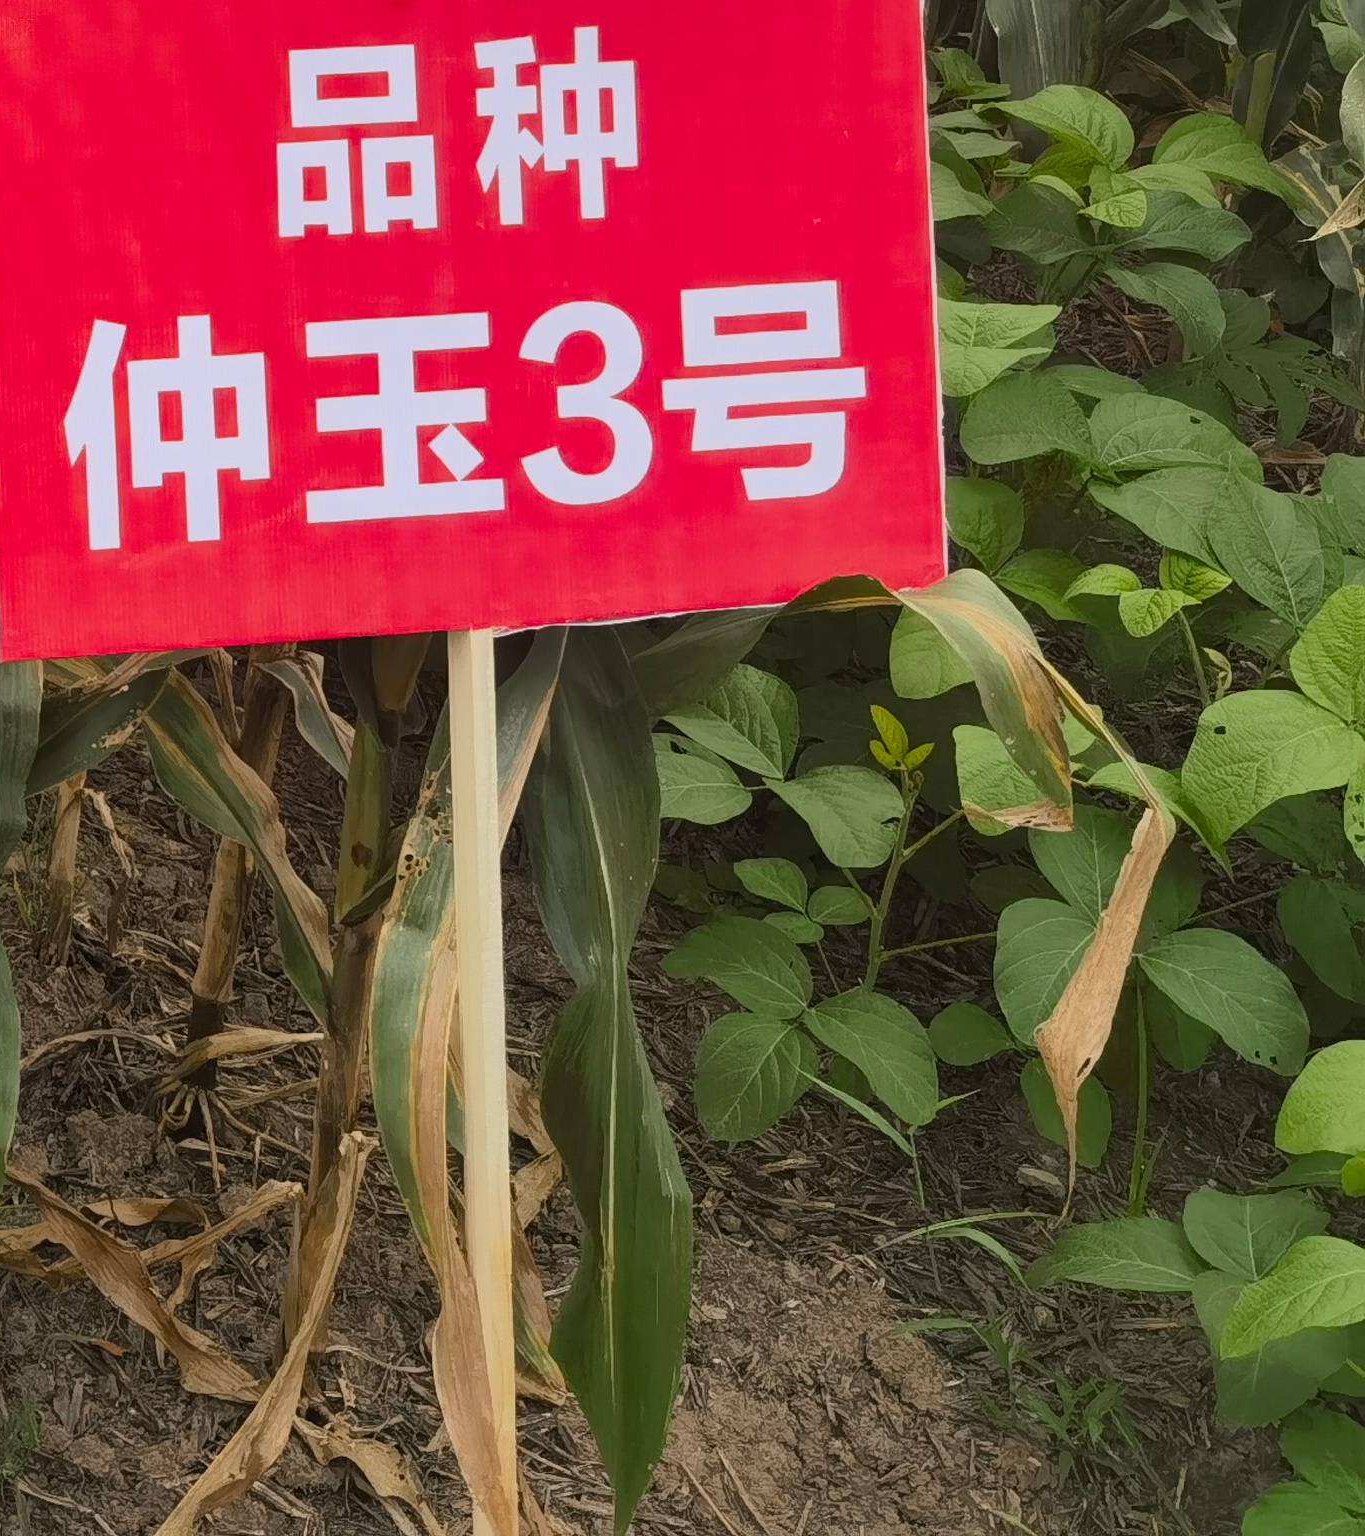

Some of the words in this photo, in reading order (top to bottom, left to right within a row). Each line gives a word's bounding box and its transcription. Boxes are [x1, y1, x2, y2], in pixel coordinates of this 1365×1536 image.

[276, 26, 638, 238] 品种
[63, 280, 867, 551] 仲玉3号
